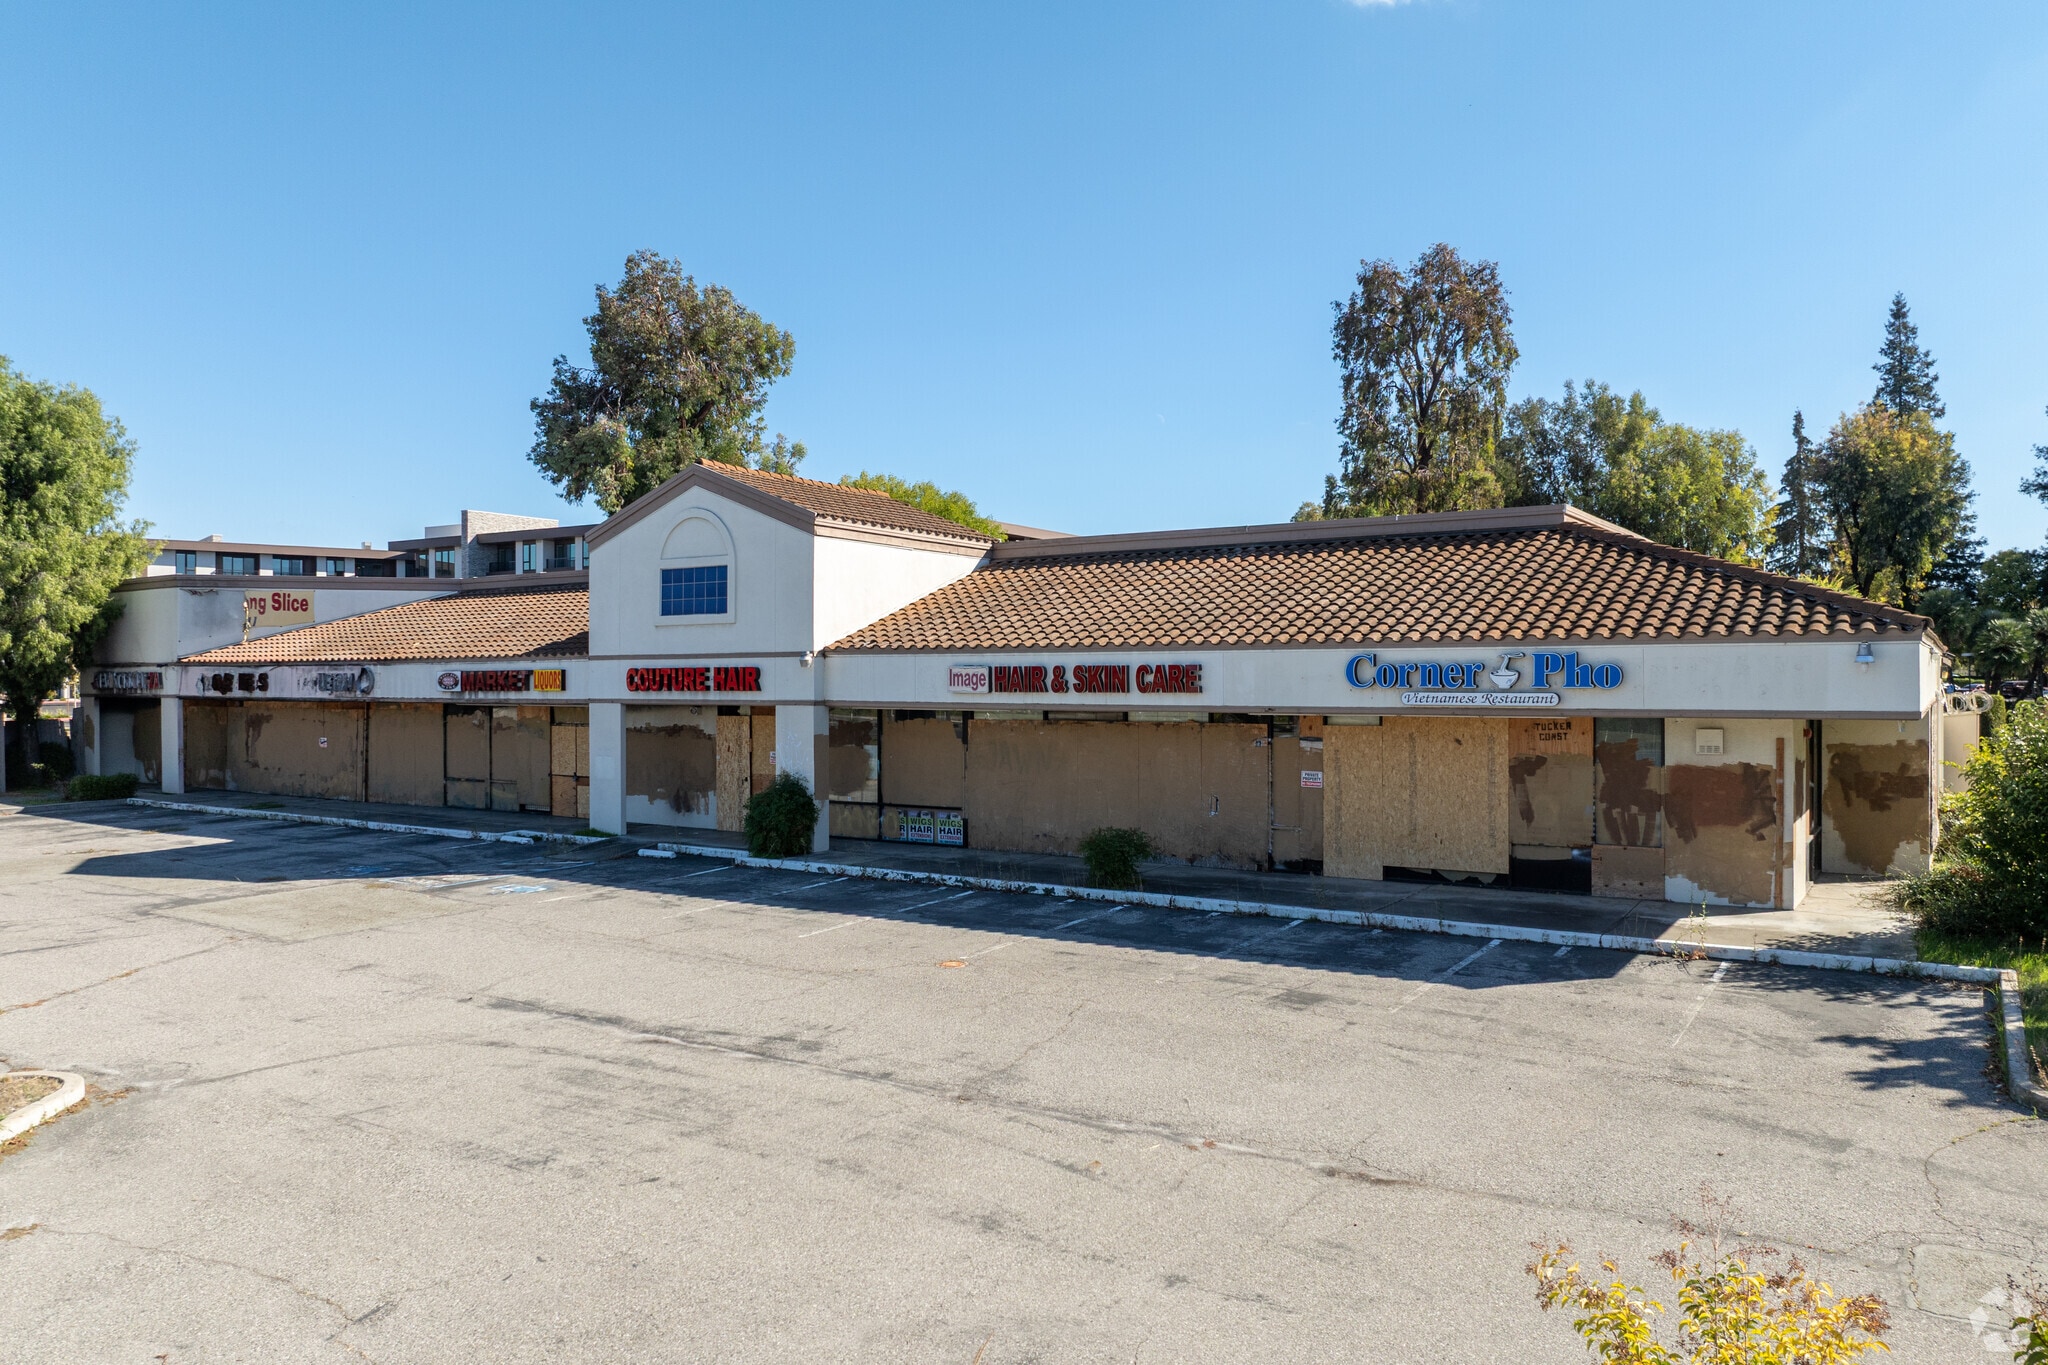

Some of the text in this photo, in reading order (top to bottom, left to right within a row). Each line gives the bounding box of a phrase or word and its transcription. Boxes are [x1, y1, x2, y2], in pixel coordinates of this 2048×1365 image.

[271, 592, 309, 612] Slice
[1345, 651, 1624, 689] Corner Pho
[461, 671, 529, 691] MARKET
[534, 670, 562, 690] LIQUORS
[626, 667, 760, 692] COUTURE HAIR
[949, 664, 1201, 694] Image HAIR & SKIN CARE
[1404, 693, 1556, 706] Vietnamese Restaurant
[1534, 721, 1572, 731] TUCKER
[1539, 732, 1568, 741] CONST
[910, 817, 932, 825] WIGS
[939, 819, 962, 828] WIGS
[910, 825, 933, 833] HAIR
[939, 827, 962, 836] HAIR
